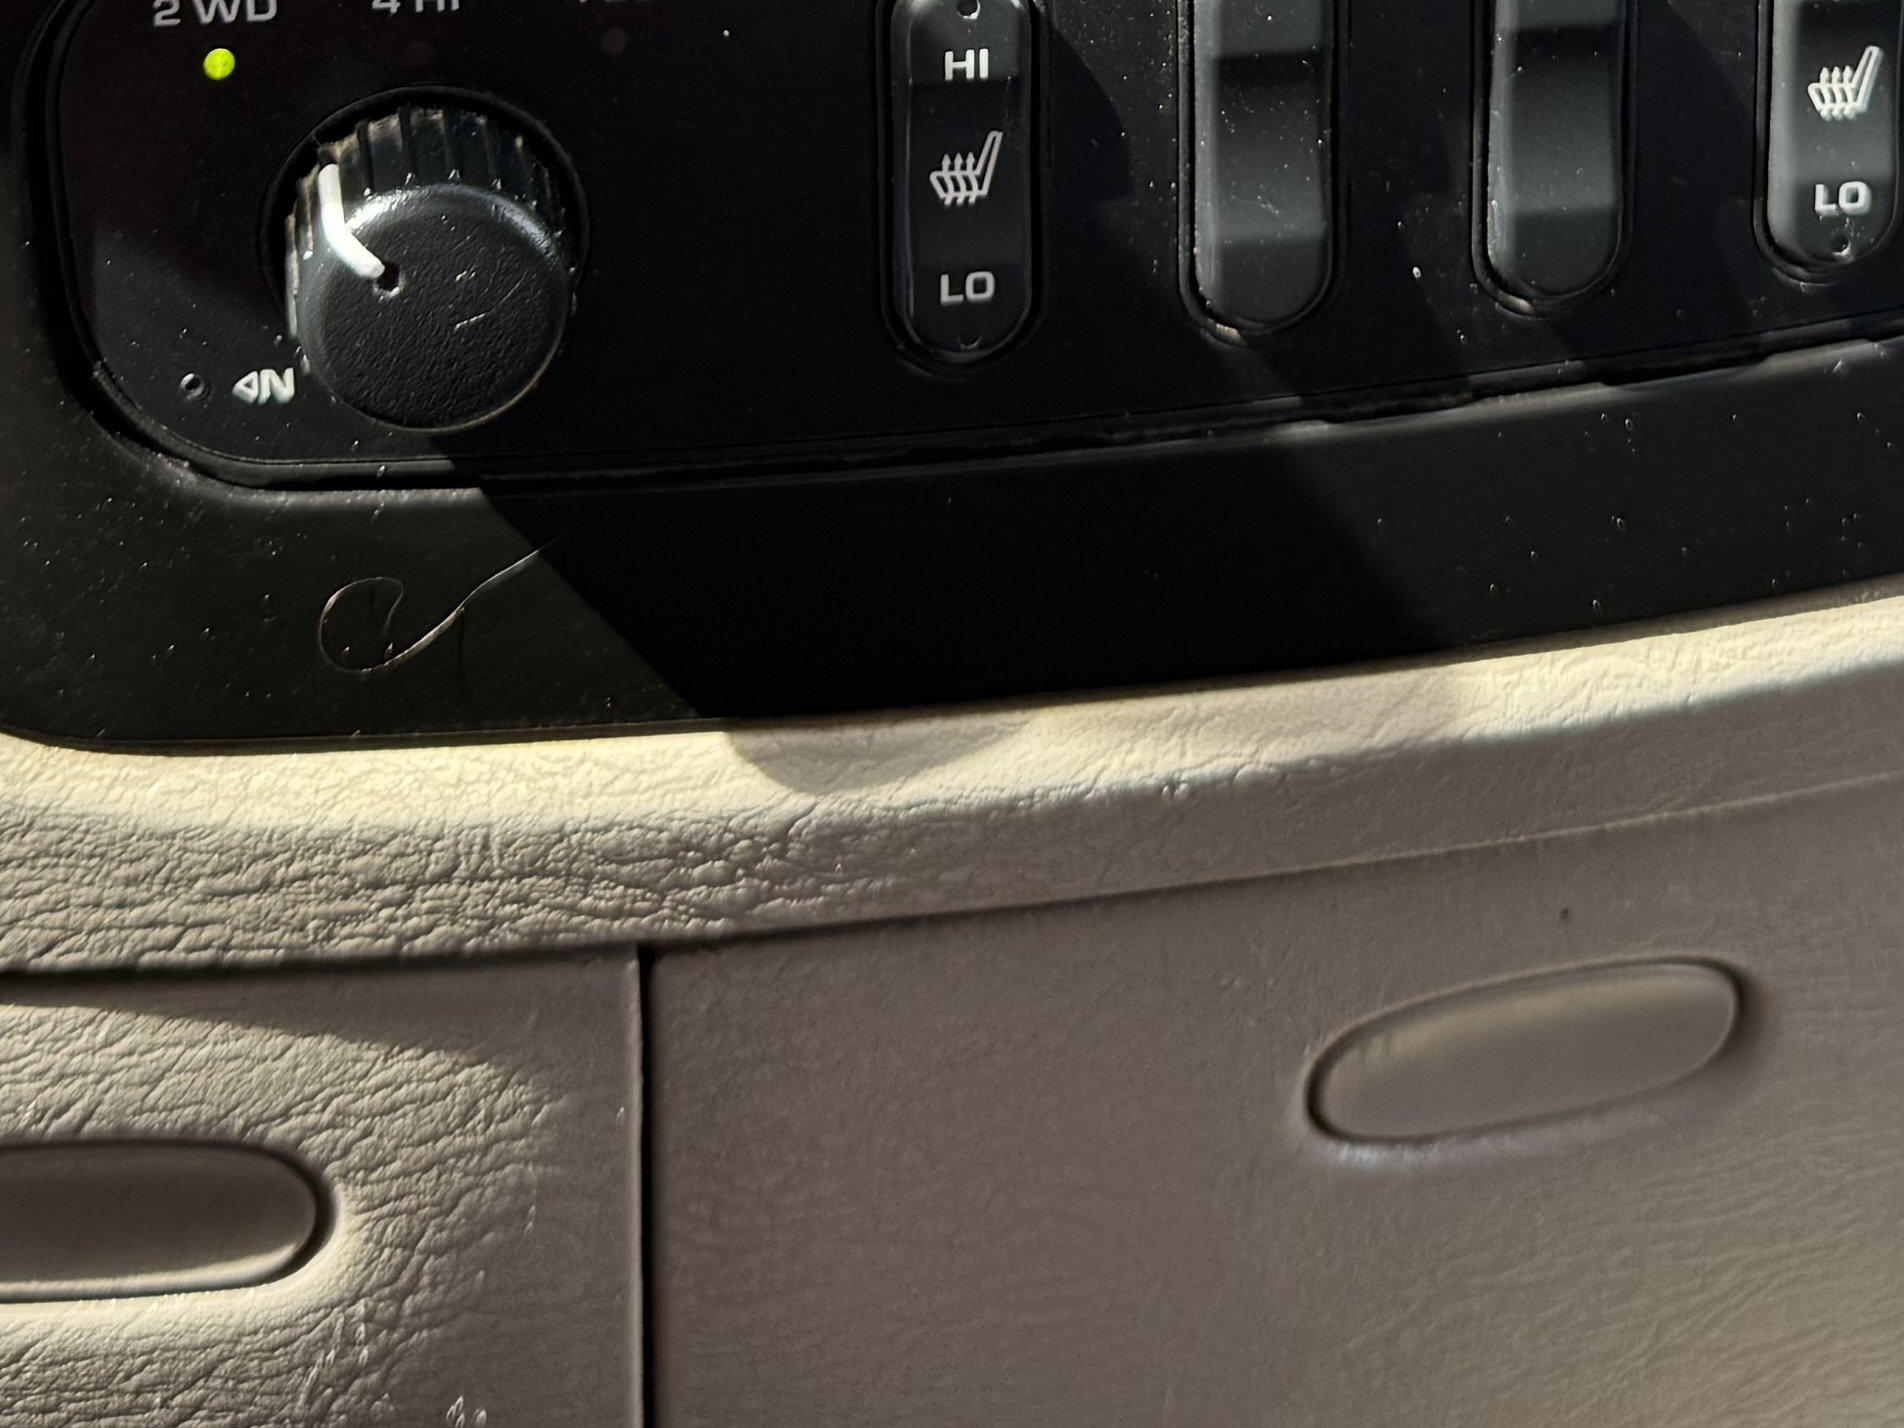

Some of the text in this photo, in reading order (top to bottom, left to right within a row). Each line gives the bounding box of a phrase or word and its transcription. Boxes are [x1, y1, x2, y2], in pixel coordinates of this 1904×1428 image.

[944, 47, 989, 81] HI
[1814, 181, 1872, 216] LO
[940, 270, 996, 305] LO
